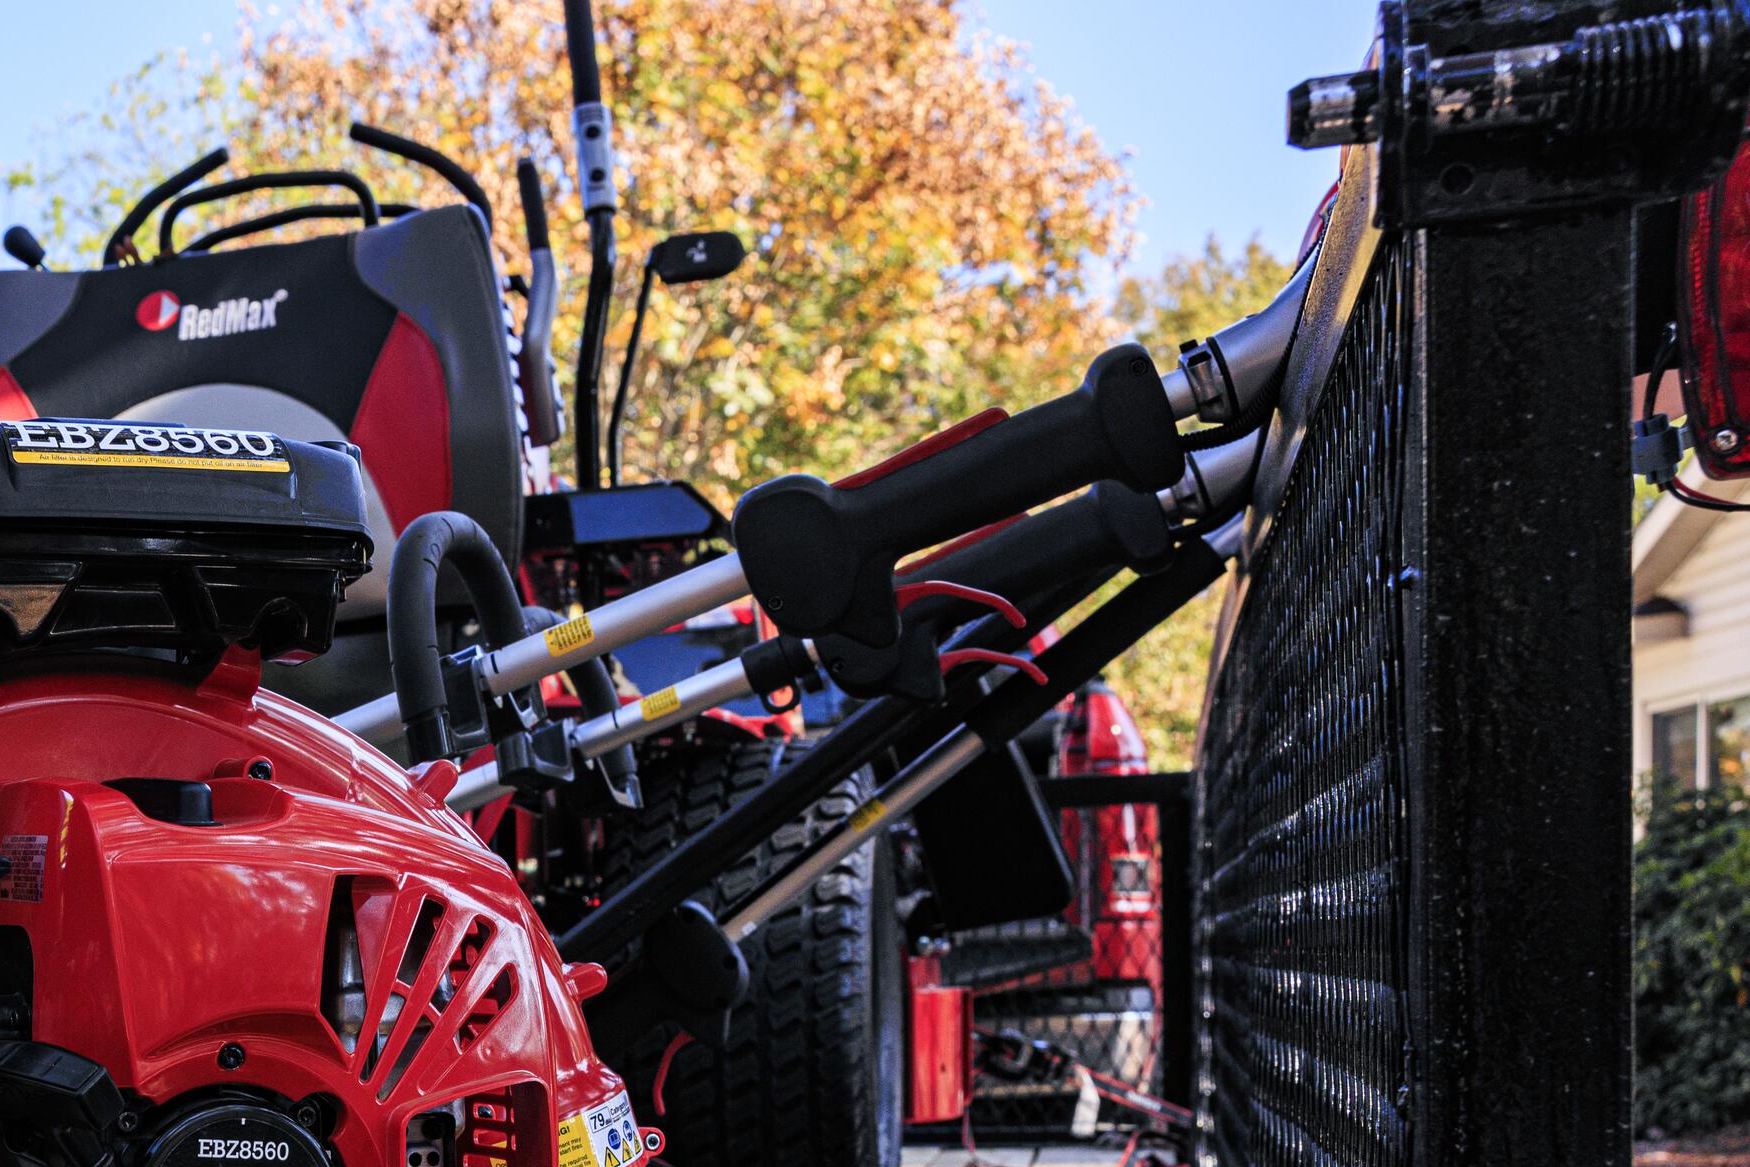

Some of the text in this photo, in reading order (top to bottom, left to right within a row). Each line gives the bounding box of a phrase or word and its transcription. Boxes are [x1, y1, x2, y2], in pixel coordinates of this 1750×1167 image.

[178, 297, 277, 341] RedMax
[15, 422, 276, 456] EBZ8560
[590, 1113, 604, 1130] 79
[198, 1139, 289, 1161] EBZ8560
